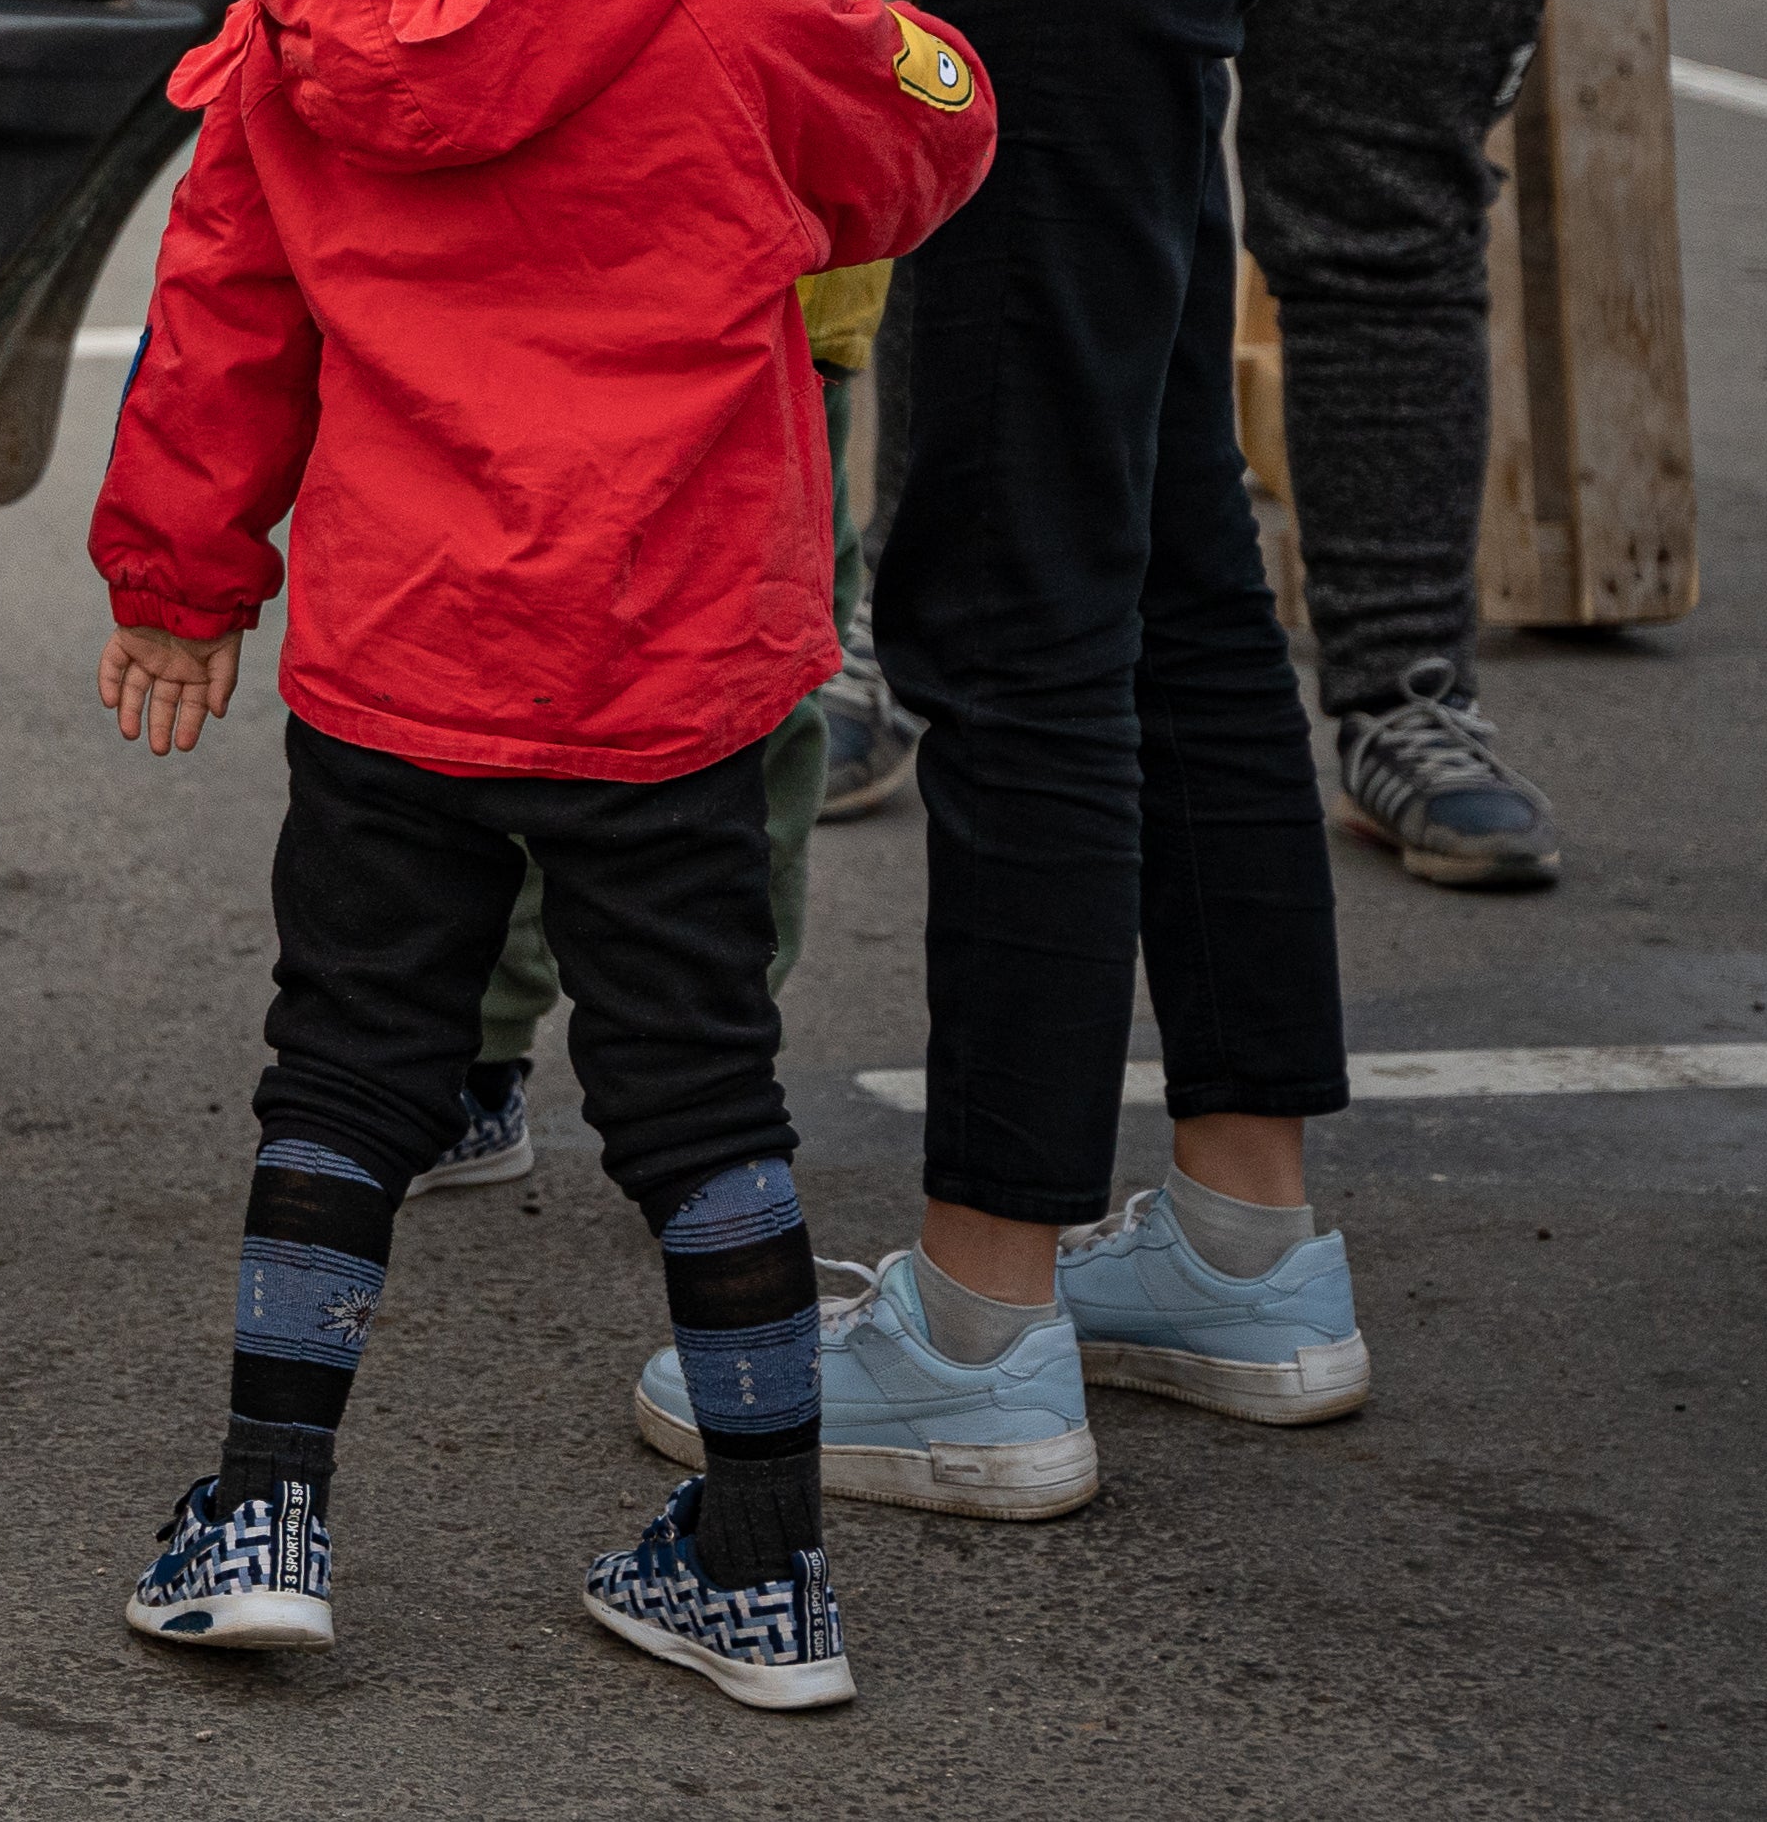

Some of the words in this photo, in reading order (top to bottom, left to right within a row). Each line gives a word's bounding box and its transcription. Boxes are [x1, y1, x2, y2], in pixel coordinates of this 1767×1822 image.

[285, 1508, 303, 1573] SPORT-KIDS
[808, 1551, 823, 1615] SPORT-KIDS
[813, 1617, 825, 1627] 3
